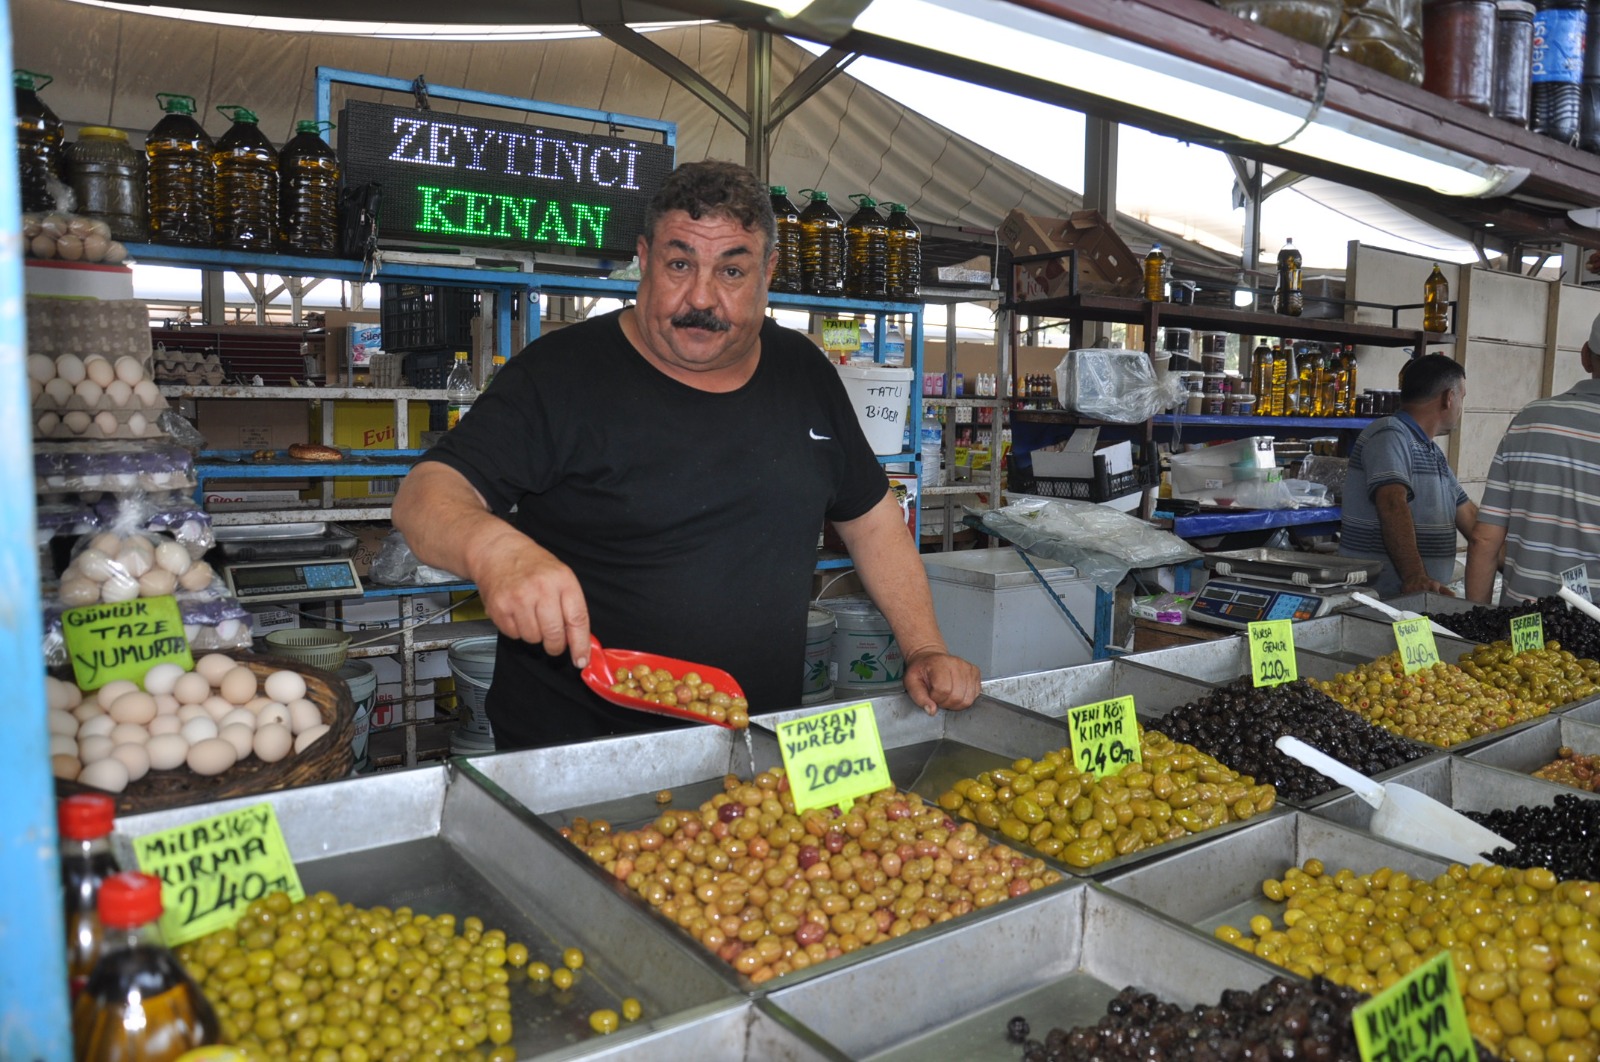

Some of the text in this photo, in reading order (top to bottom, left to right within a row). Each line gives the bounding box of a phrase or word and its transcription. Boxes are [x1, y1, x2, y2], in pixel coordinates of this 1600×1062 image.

[388, 117, 642, 190] ZEYTİNCİ
[415, 185, 611, 249] KENAN
[363, 425, 395, 448] Evi
[67, 602, 149, 627] GÜNLÜK
[89, 620, 169, 640] TAZE
[75, 636, 186, 684] YUMURTA
[782, 709, 857, 736] TAVŞAN
[1080, 719, 1123, 743] KIRMA
[154, 837, 268, 886] KIRMA
